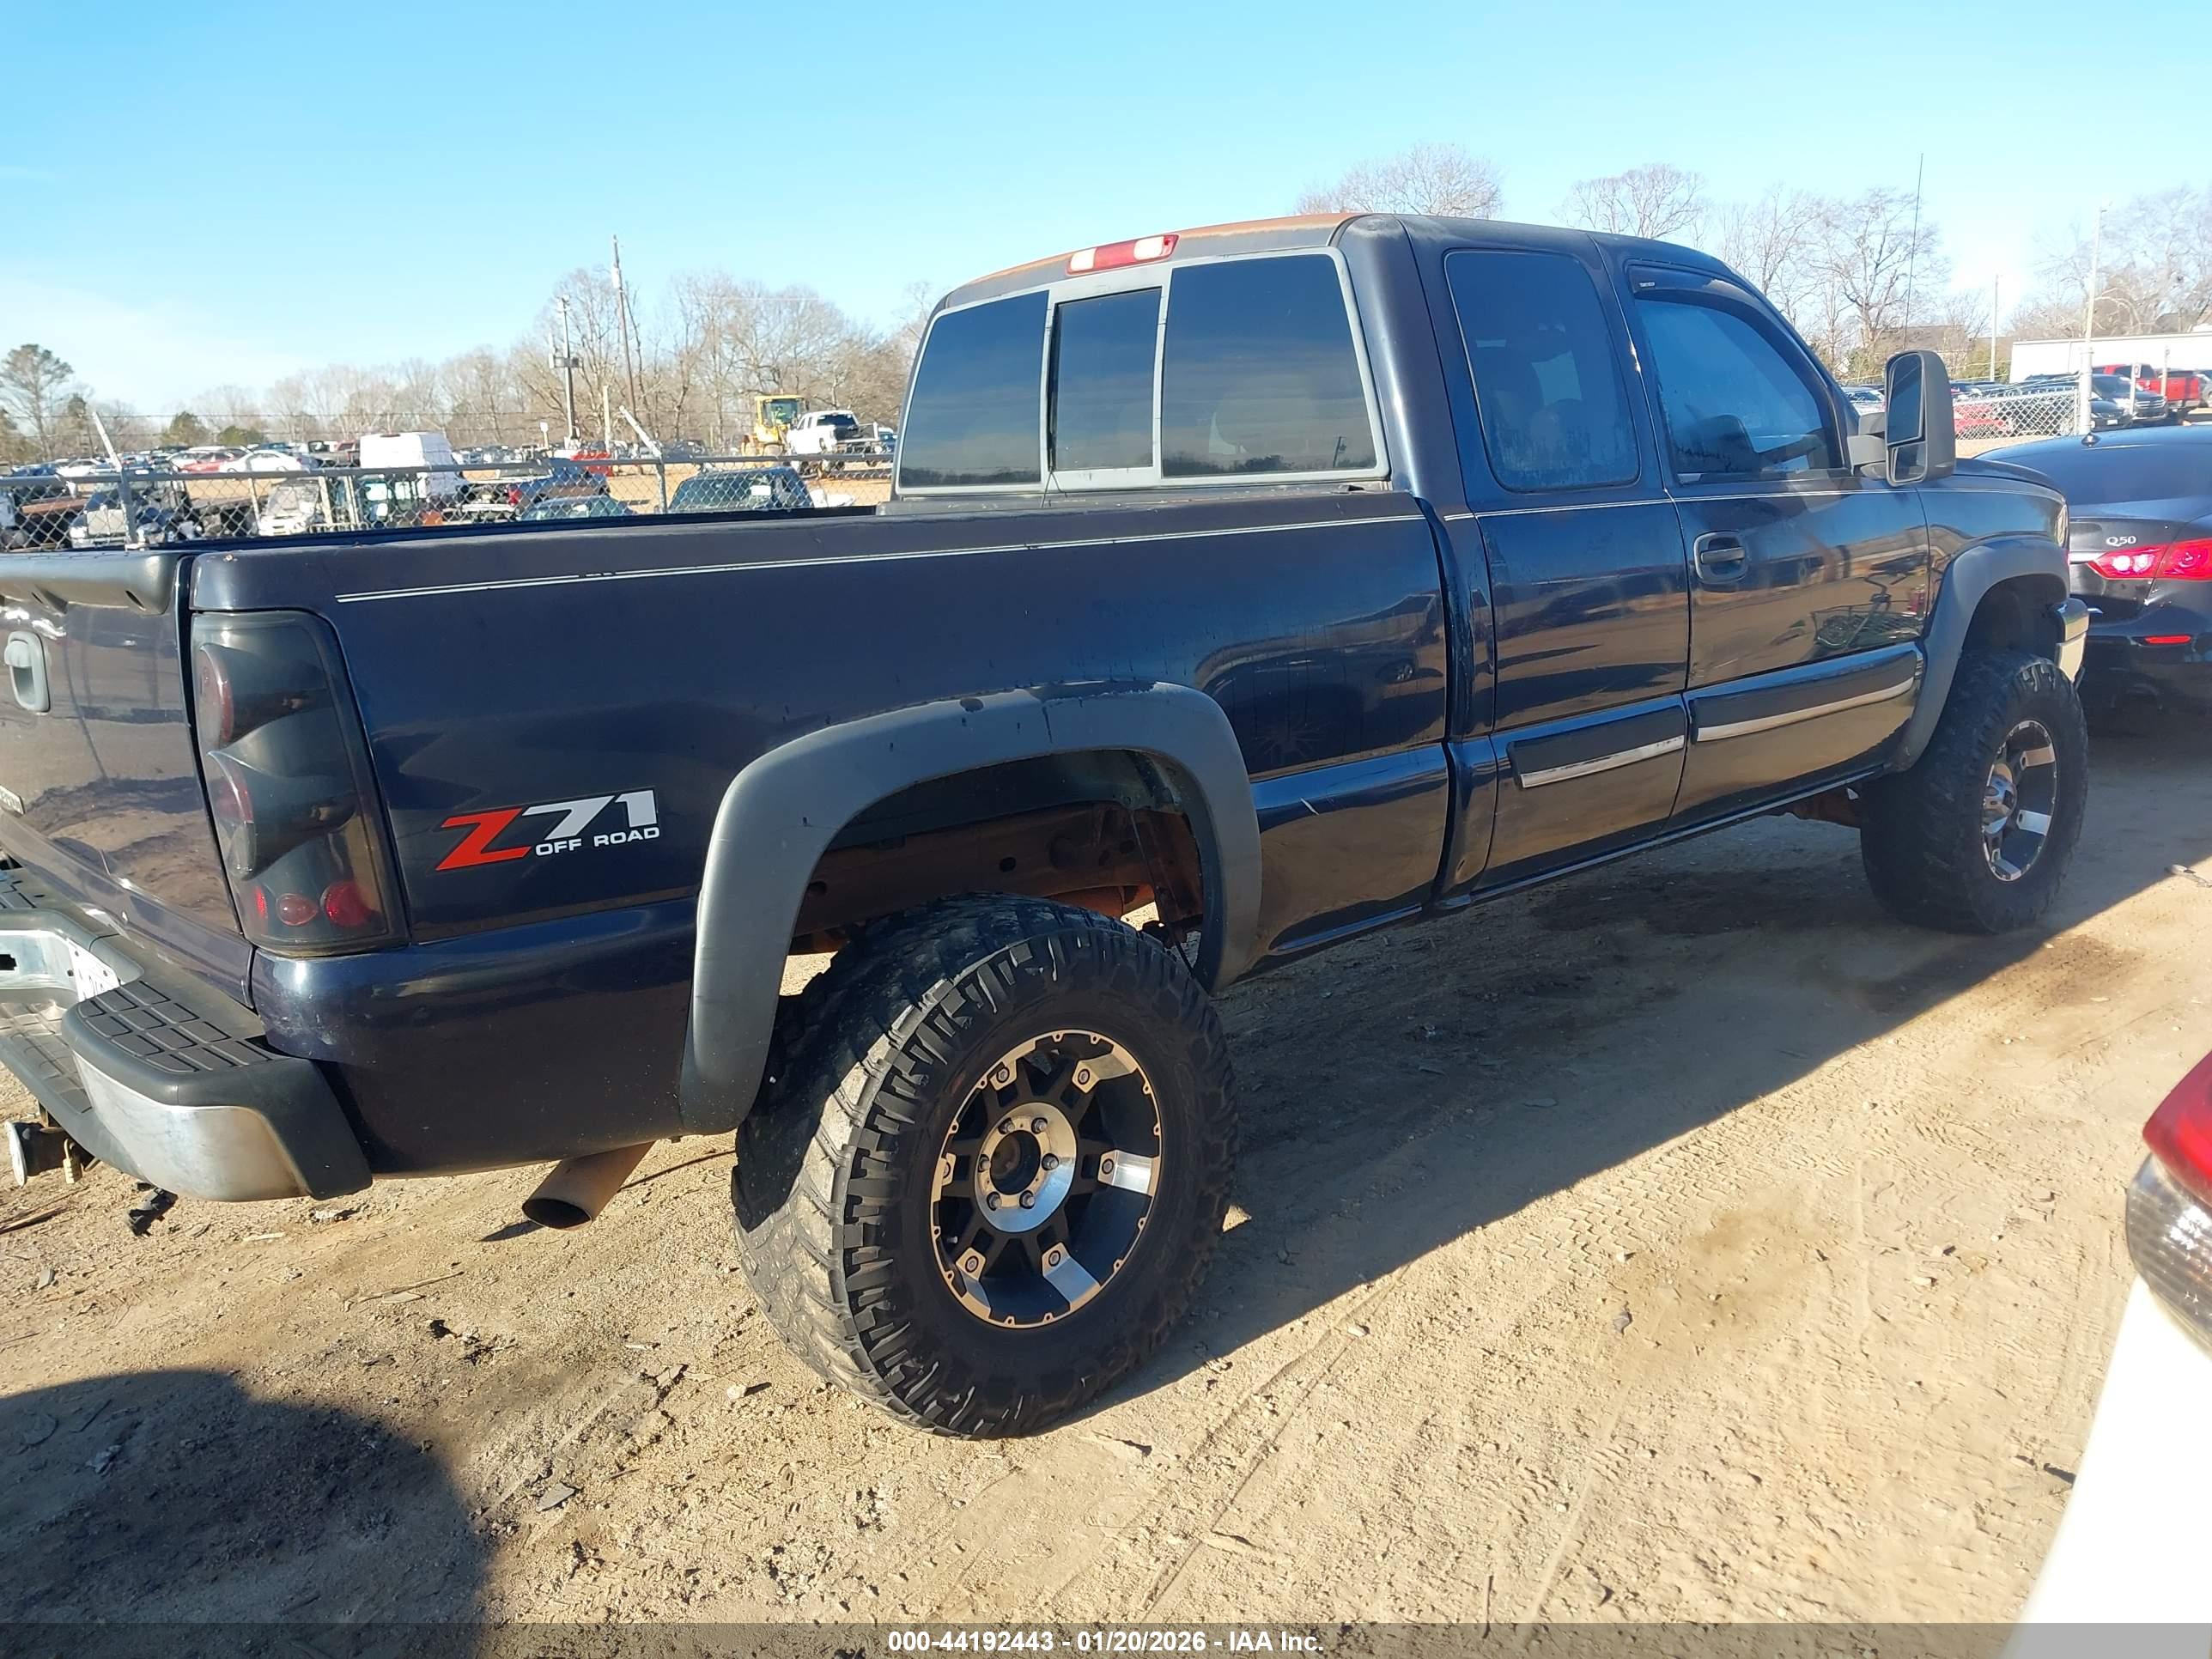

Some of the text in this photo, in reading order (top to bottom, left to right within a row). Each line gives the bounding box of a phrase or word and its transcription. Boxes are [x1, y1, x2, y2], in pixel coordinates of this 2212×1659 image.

[2106, 535, 2137, 547] Q50
[434, 789, 658, 871] Z71
[535, 826, 660, 857] OFF ROAD
